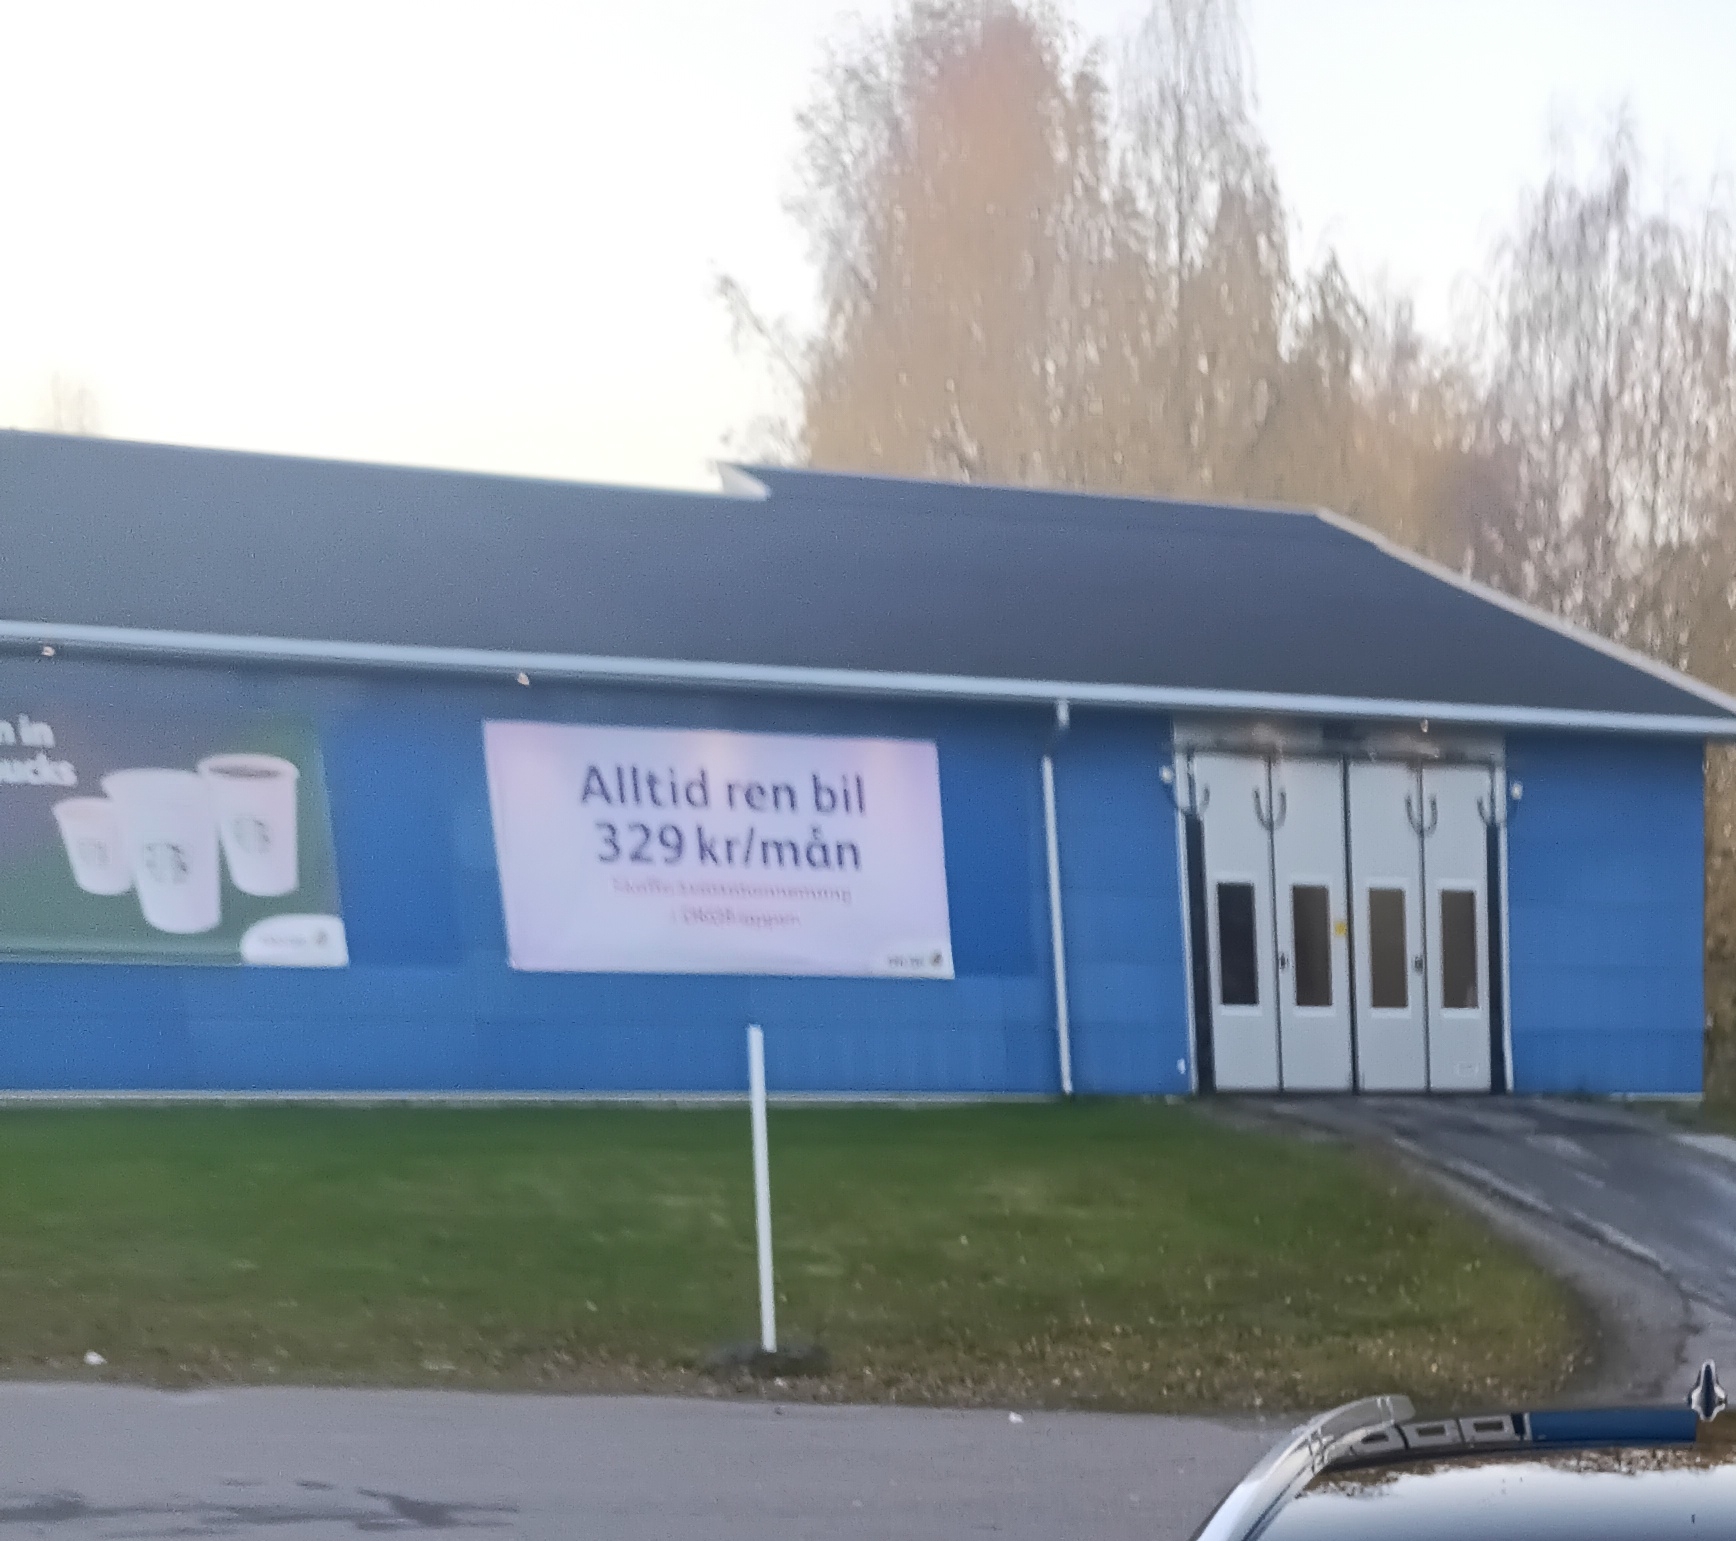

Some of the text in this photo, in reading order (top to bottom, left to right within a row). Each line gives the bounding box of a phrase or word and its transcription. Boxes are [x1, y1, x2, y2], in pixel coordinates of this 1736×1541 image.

[582, 764, 866, 814] Alltid ren bil
[596, 821, 861, 870] 329 kr/mån
